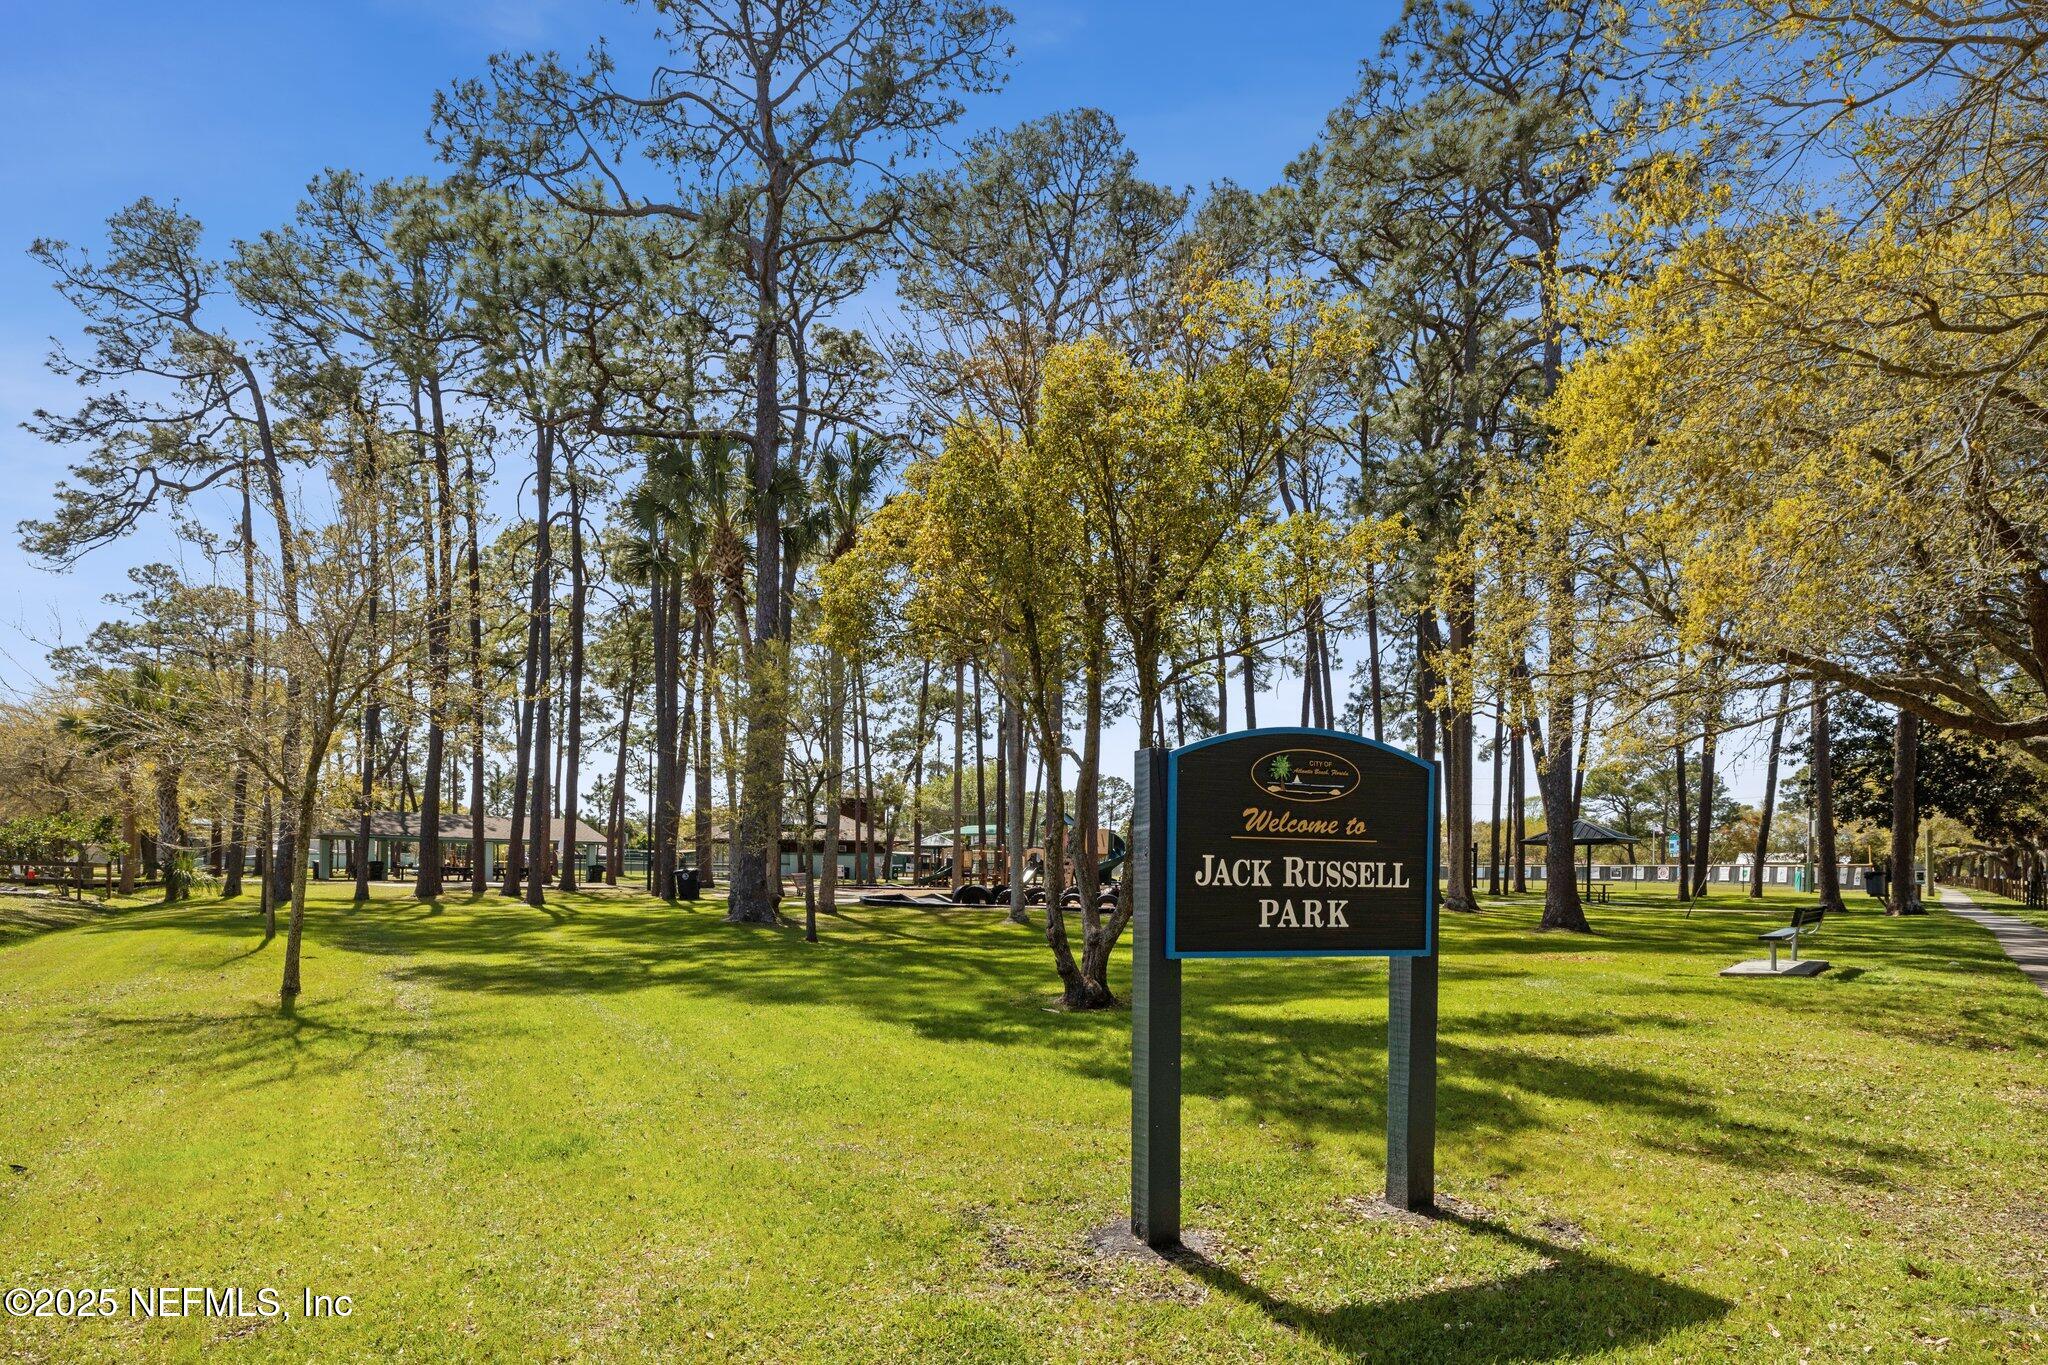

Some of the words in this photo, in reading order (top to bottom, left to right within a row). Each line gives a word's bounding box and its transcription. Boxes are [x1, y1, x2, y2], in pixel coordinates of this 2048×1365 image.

[1242, 807, 1339, 834] Welcome
[1345, 817, 1367, 835] to
[1195, 854, 1272, 887] JACK
[1283, 856, 1410, 889] RUSSELL
[1258, 899, 1350, 928] PARK
